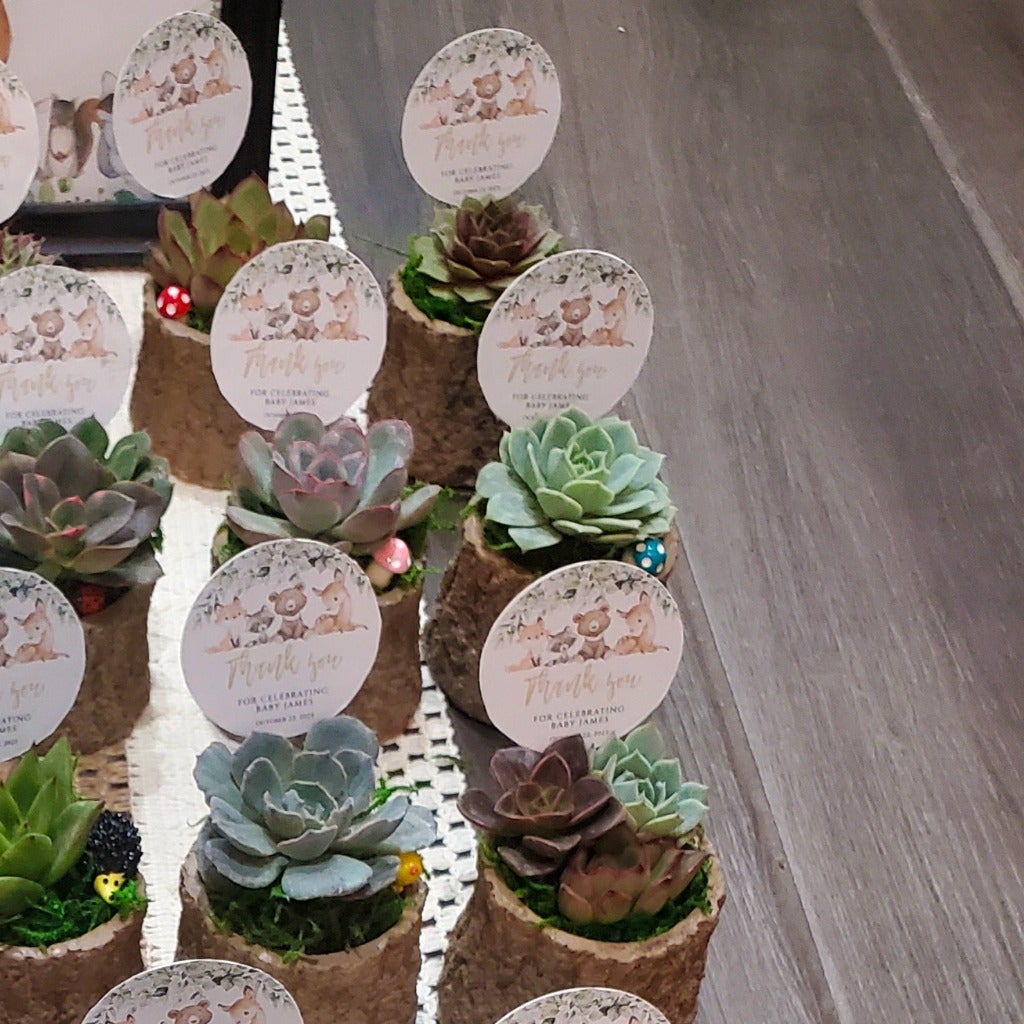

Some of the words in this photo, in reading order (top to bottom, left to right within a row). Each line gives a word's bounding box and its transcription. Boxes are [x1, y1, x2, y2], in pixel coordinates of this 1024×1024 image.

[227, 644, 300, 689] Thank
[307, 651, 343, 683] you
[525, 664, 597, 707] Thank
[606, 670, 642, 702] you
[11, 680, 47, 710] you
